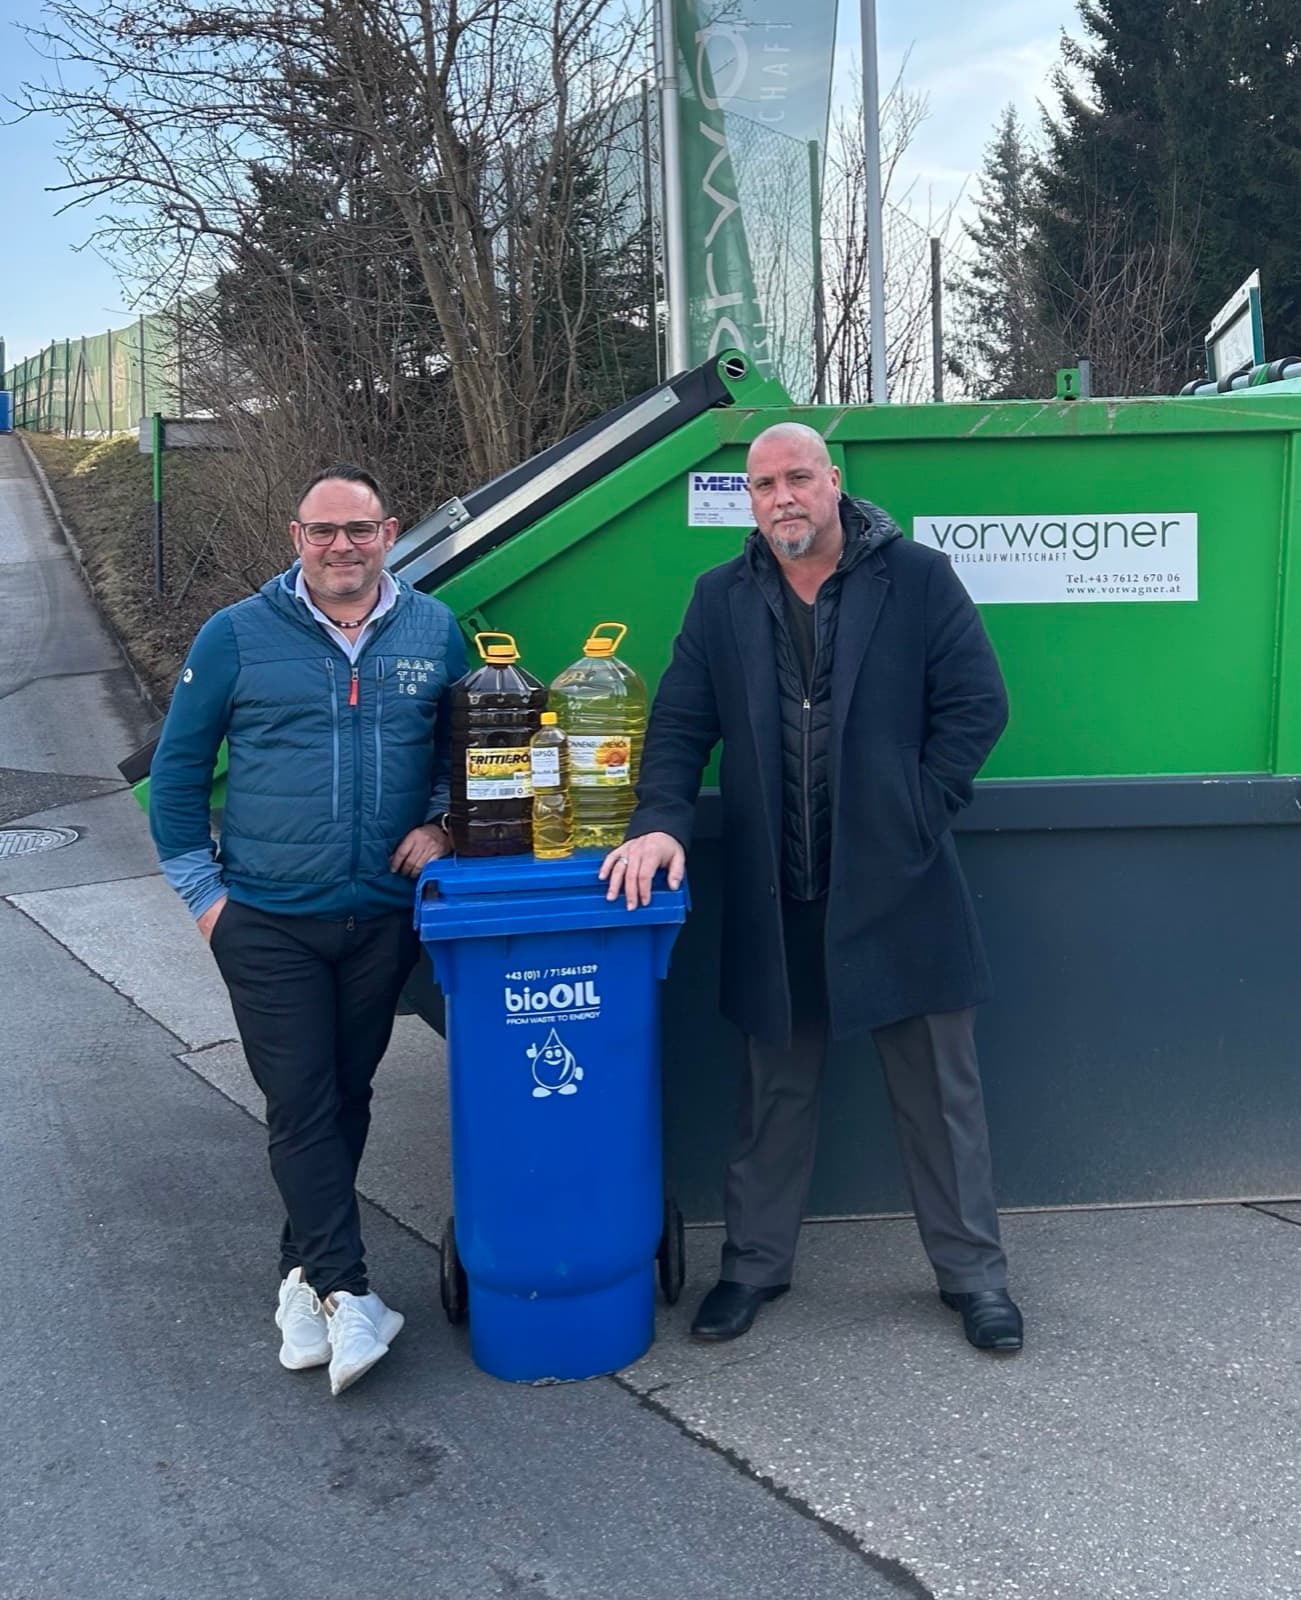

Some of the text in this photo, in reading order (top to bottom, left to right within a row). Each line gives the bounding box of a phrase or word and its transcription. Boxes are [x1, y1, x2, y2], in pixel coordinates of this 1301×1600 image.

[931, 520, 1181, 561] vorwagner
[948, 552, 1067, 563] EISLAUFWIRTSCHAFT
[1112, 574, 1139, 583] 7612
[1143, 573, 1163, 582] 670
[1167, 573, 1181, 582] 06
[1066, 584, 1181, 596] www.vorwagner.at
[505, 971, 522, 980] +43
[505, 980, 600, 1012] bioOIL
[506, 1011, 600, 1025] FROM WASTE TO ENERGY
